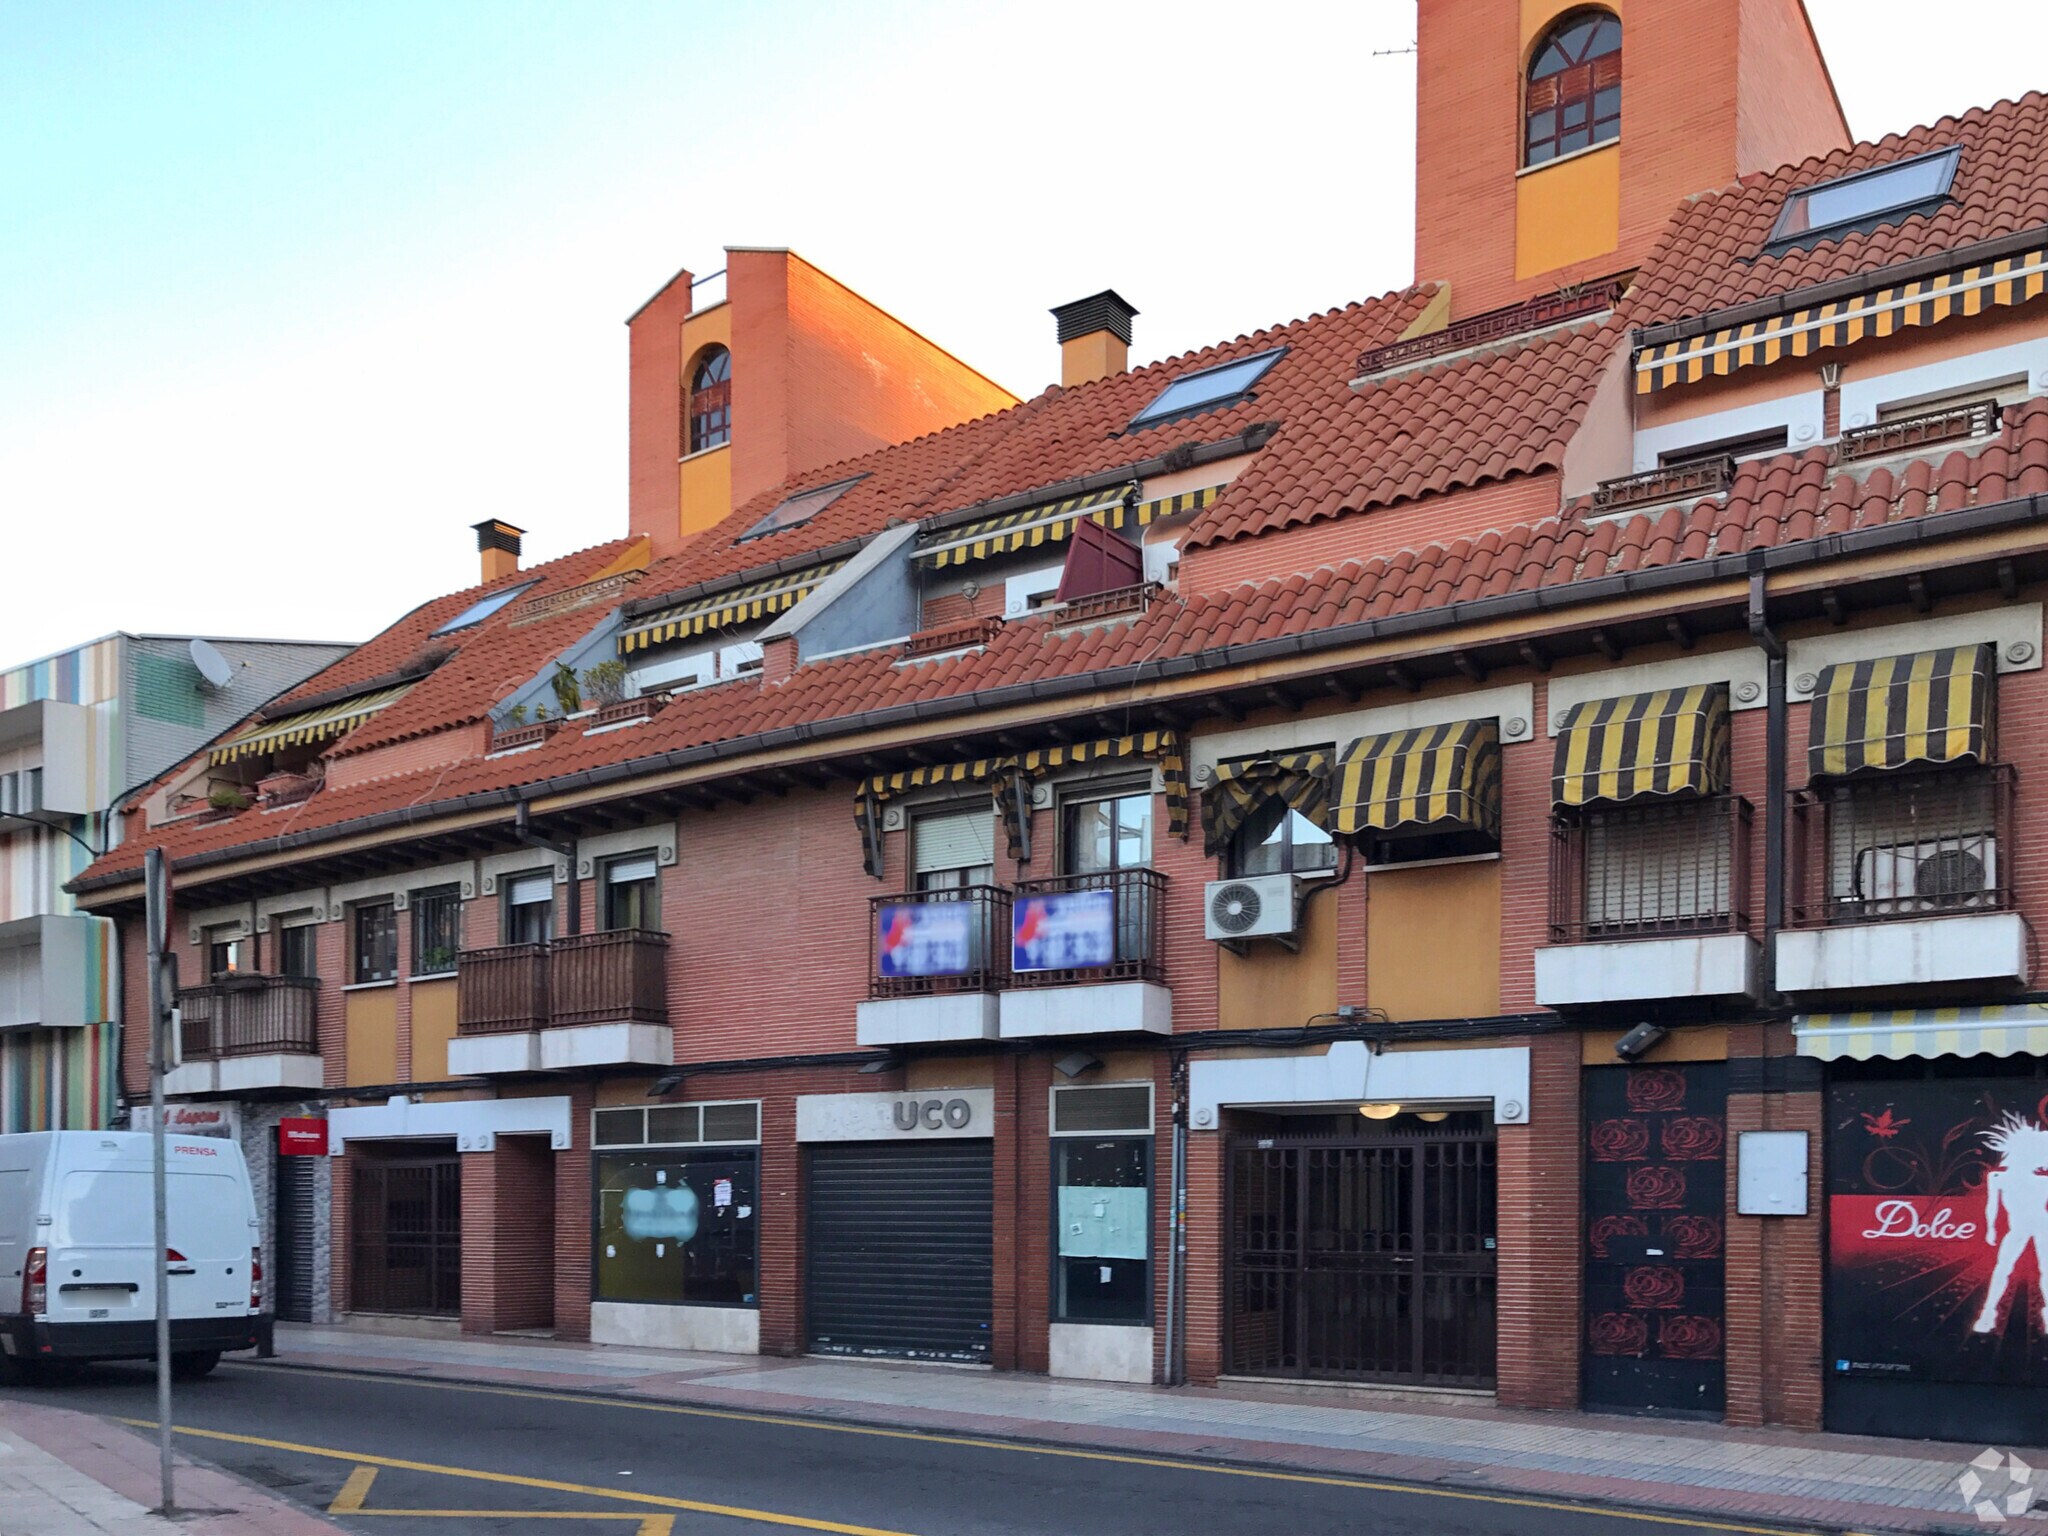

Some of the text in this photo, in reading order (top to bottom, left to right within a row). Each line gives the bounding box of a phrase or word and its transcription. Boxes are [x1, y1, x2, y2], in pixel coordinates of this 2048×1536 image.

[893, 1099, 971, 1131] UCO
[174, 1146, 217, 1157] PRENSA
[1862, 1200, 1977, 1239] Dolce
